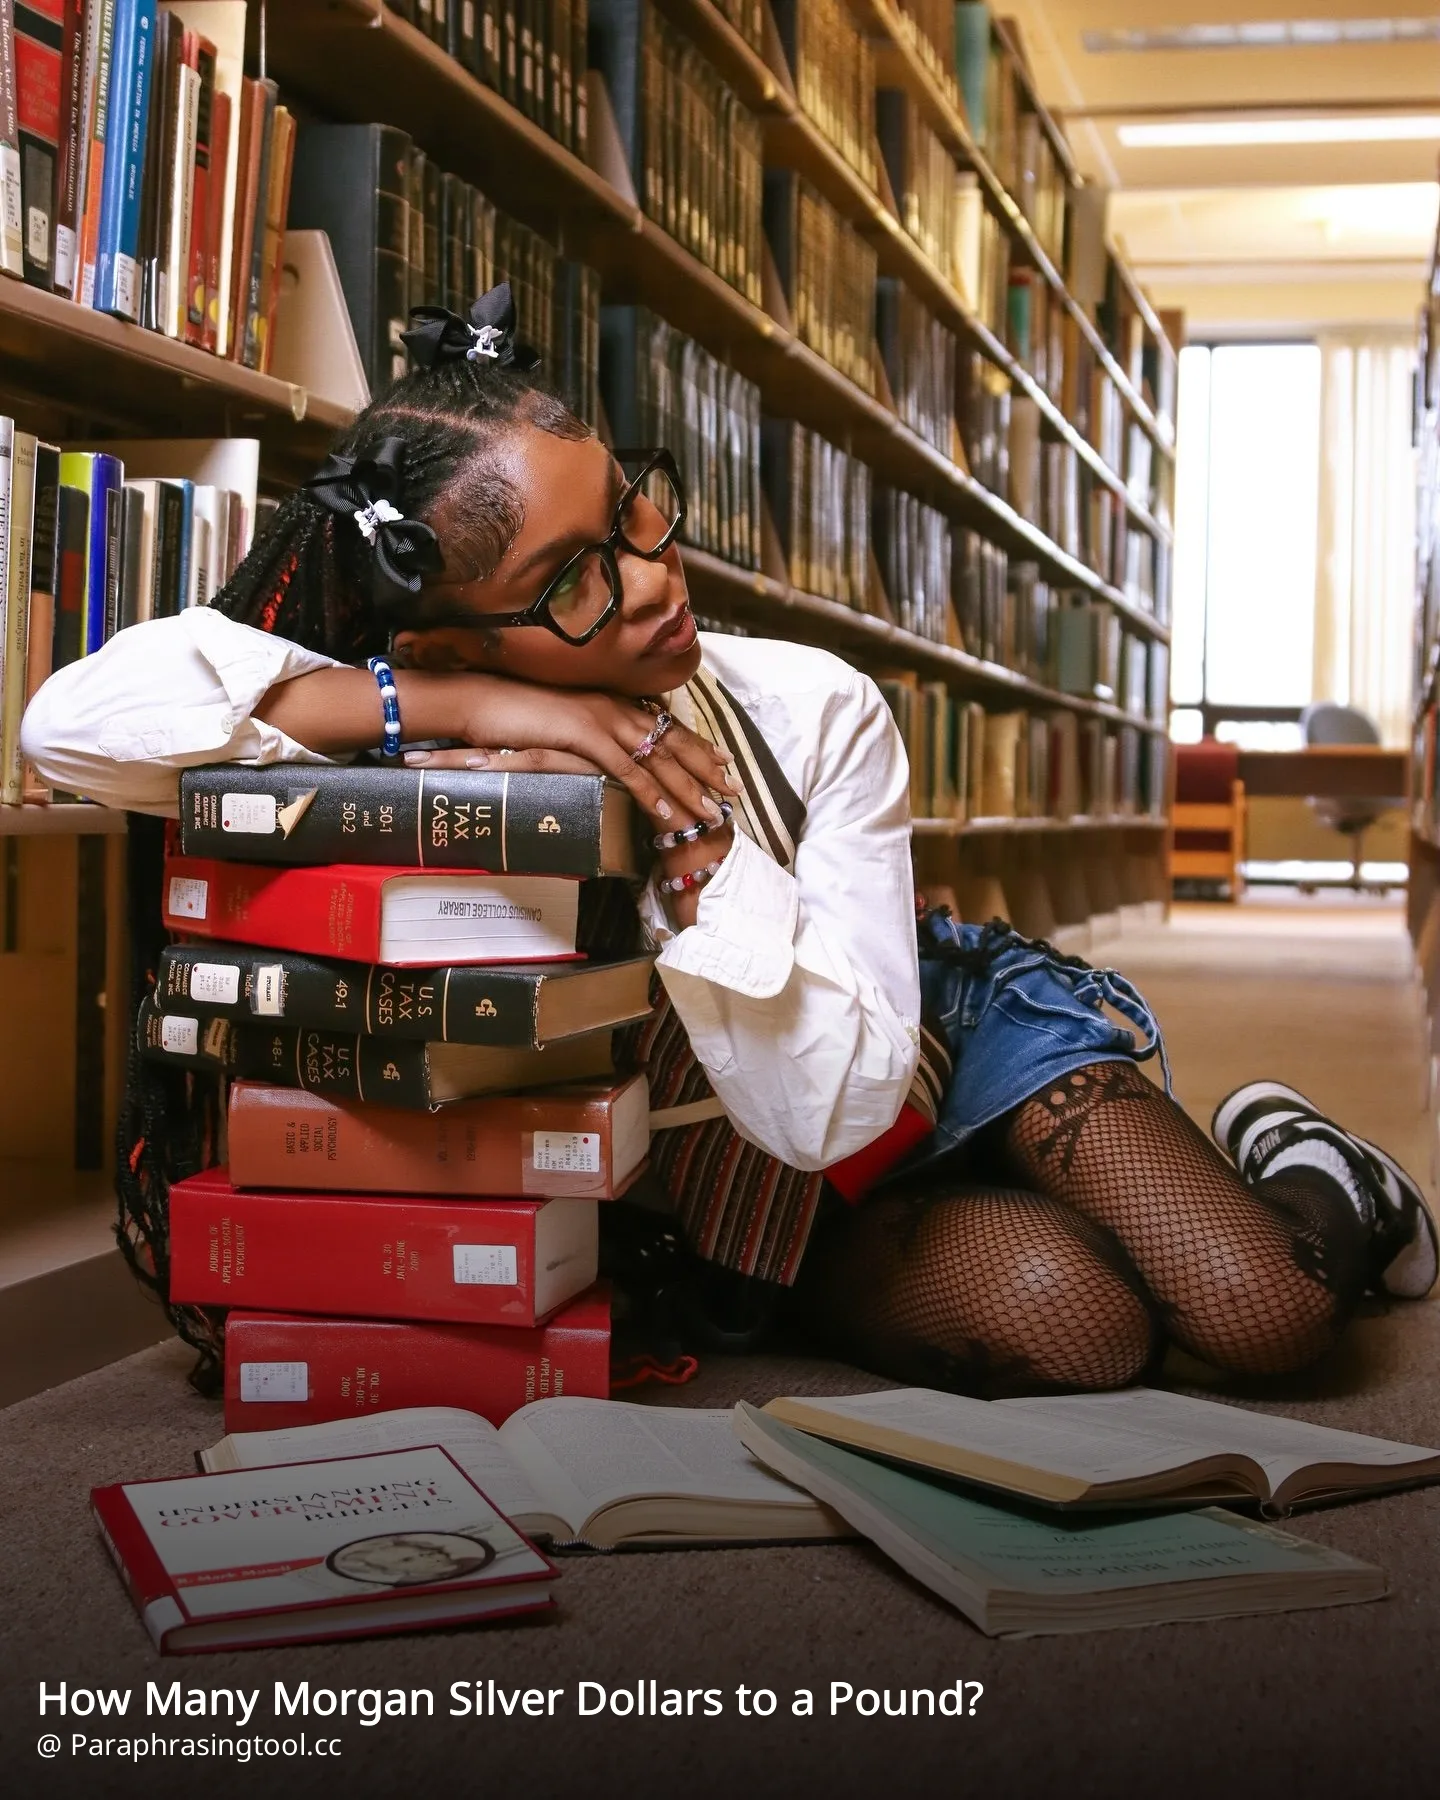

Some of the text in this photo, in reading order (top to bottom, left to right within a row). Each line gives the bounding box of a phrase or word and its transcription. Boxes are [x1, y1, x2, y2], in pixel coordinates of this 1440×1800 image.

[102, 30, 111, 50] ARE
[102, 51, 110, 60] A
[137, 36, 146, 66] FEDERAL
[72, 54, 80, 87] Crisis
[98, 62, 108, 104] WOMAN'S
[6, 87, 12, 102] of
[72, 90, 78, 102] in
[134, 69, 144, 111] TAXATION
[70, 106, 79, 125] Tax
[96, 107, 105, 138] ISSUE
[134, 110, 142, 119] IN
[132, 120, 140, 152] AMERICA
[67, 127, 77, 212] Administration
[20, 538, 24, 547] in
[16, 570, 24, 602] Policy
[15, 606, 24, 651] Analysis
[342, 802, 356, 833] 50-2
[363, 810, 373, 827] and
[380, 805, 393, 834] 50-1
[432, 794, 449, 848] CASES
[454, 802, 470, 840] TAX
[438, 900, 542, 922] CANISIUS COLLEGE LIBRARY
[182, 962, 190, 996] COMMERCE
[245, 974, 254, 998] Index
[335, 979, 348, 1009] 49-1
[378, 972, 395, 1025] CASES
[398, 984, 414, 1020] TAX
[272, 1036, 282, 1067] 48-1
[306, 1033, 320, 1084] CASES
[322, 1044, 335, 1080] TAX
[286, 1131, 296, 1154] BASIC
[300, 1123, 310, 1152] APPLIED
[314, 1126, 324, 1152] SOCIAL
[328, 1116, 338, 1160] PSYCHOLOGY
[1252, 1128, 1280, 1164] NIKE
[209, 1238, 218, 1273] JOURNAL
[222, 1216, 232, 1284] APPLIED SOCIAL
[236, 1224, 245, 1276] PSYCHOLOGY
[383, 1244, 392, 1275] VOL. 30
[410, 1250, 418, 1272] 2000
[341, 1376, 350, 1398] 2000
[370, 1372, 380, 1404] VOL. 30
[540, 1357, 550, 1394] APPLIED
[158, 1478, 436, 1518] UNDERSTANDING
[160, 1486, 438, 1528] GOVERNMENT
[304, 1498, 453, 1522] BUDGETS
[198, 1572, 237, 1584] Mark
